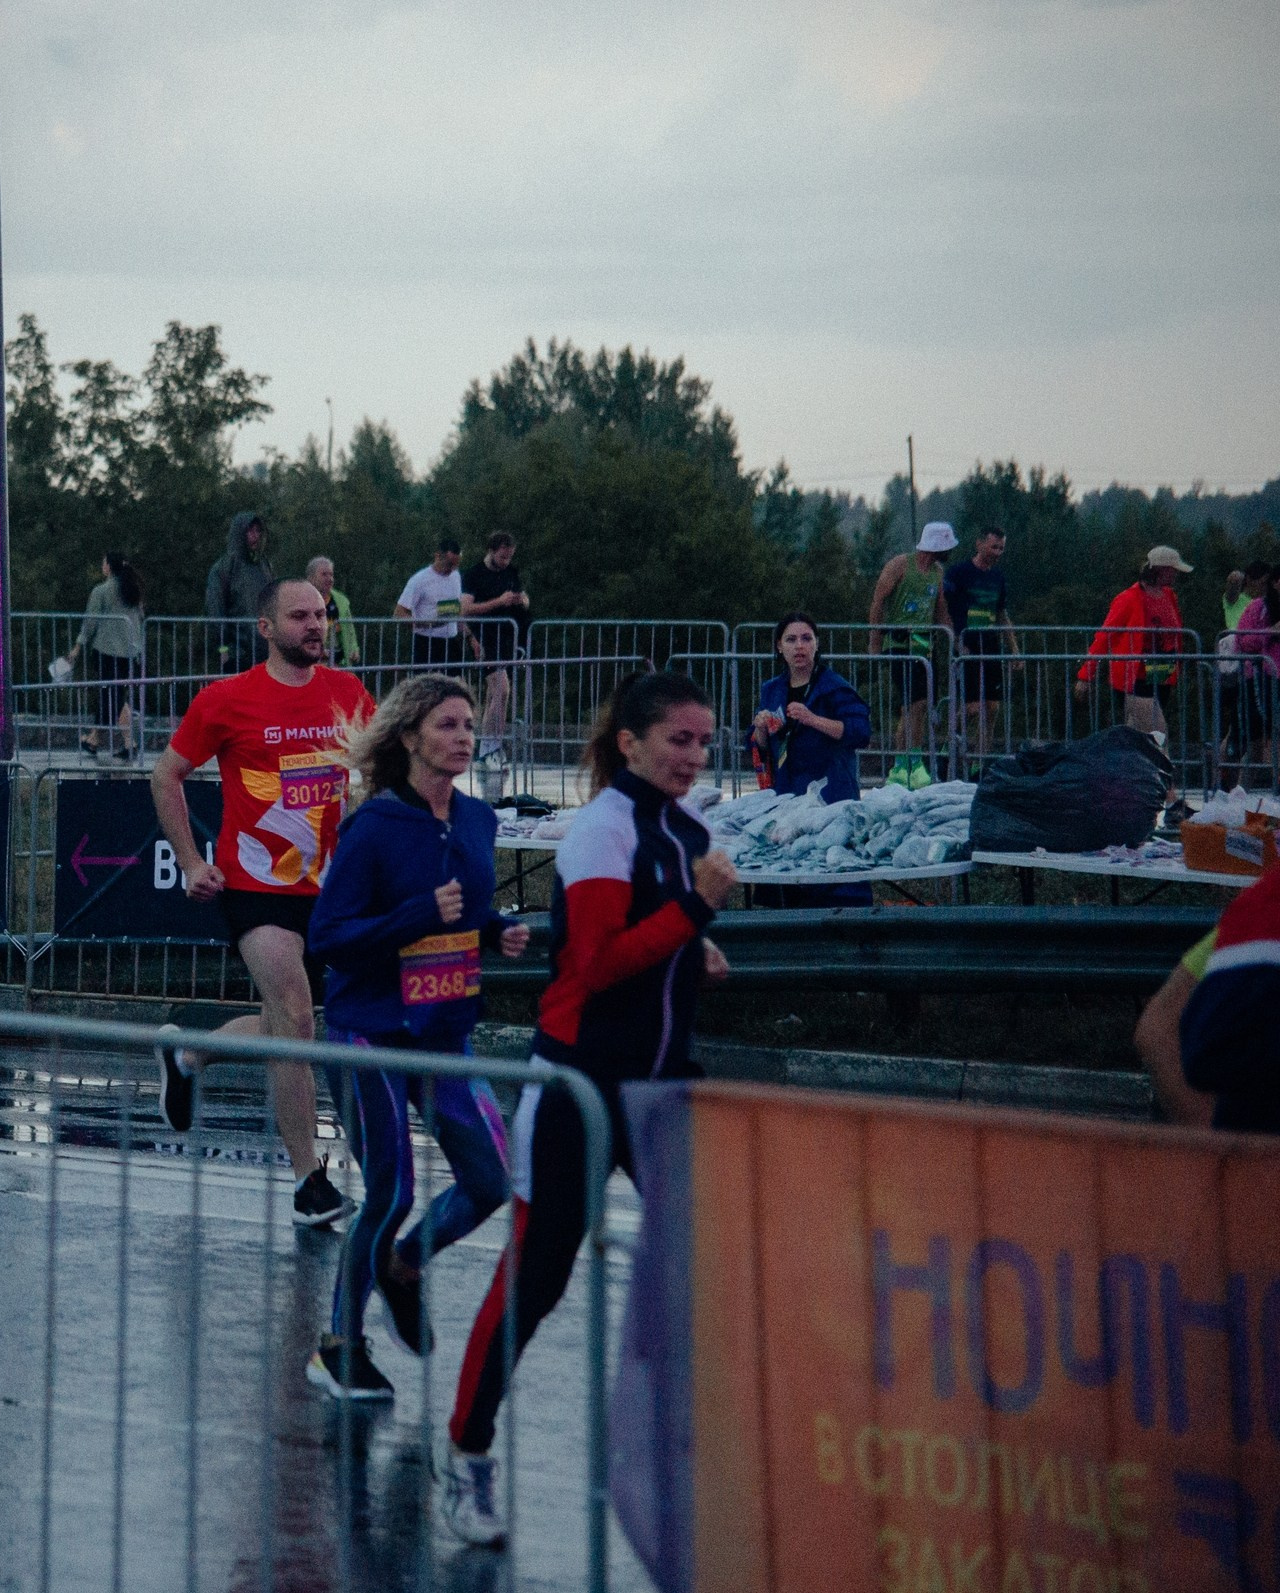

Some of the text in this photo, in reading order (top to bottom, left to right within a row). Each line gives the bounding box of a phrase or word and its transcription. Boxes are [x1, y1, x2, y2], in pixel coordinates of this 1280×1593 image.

[286, 782, 332, 805] 3012
[408, 971, 464, 1000] 2368
[812, 1410, 845, 1485] В
[852, 1426, 1150, 1546] СТОЛИЦЕ
